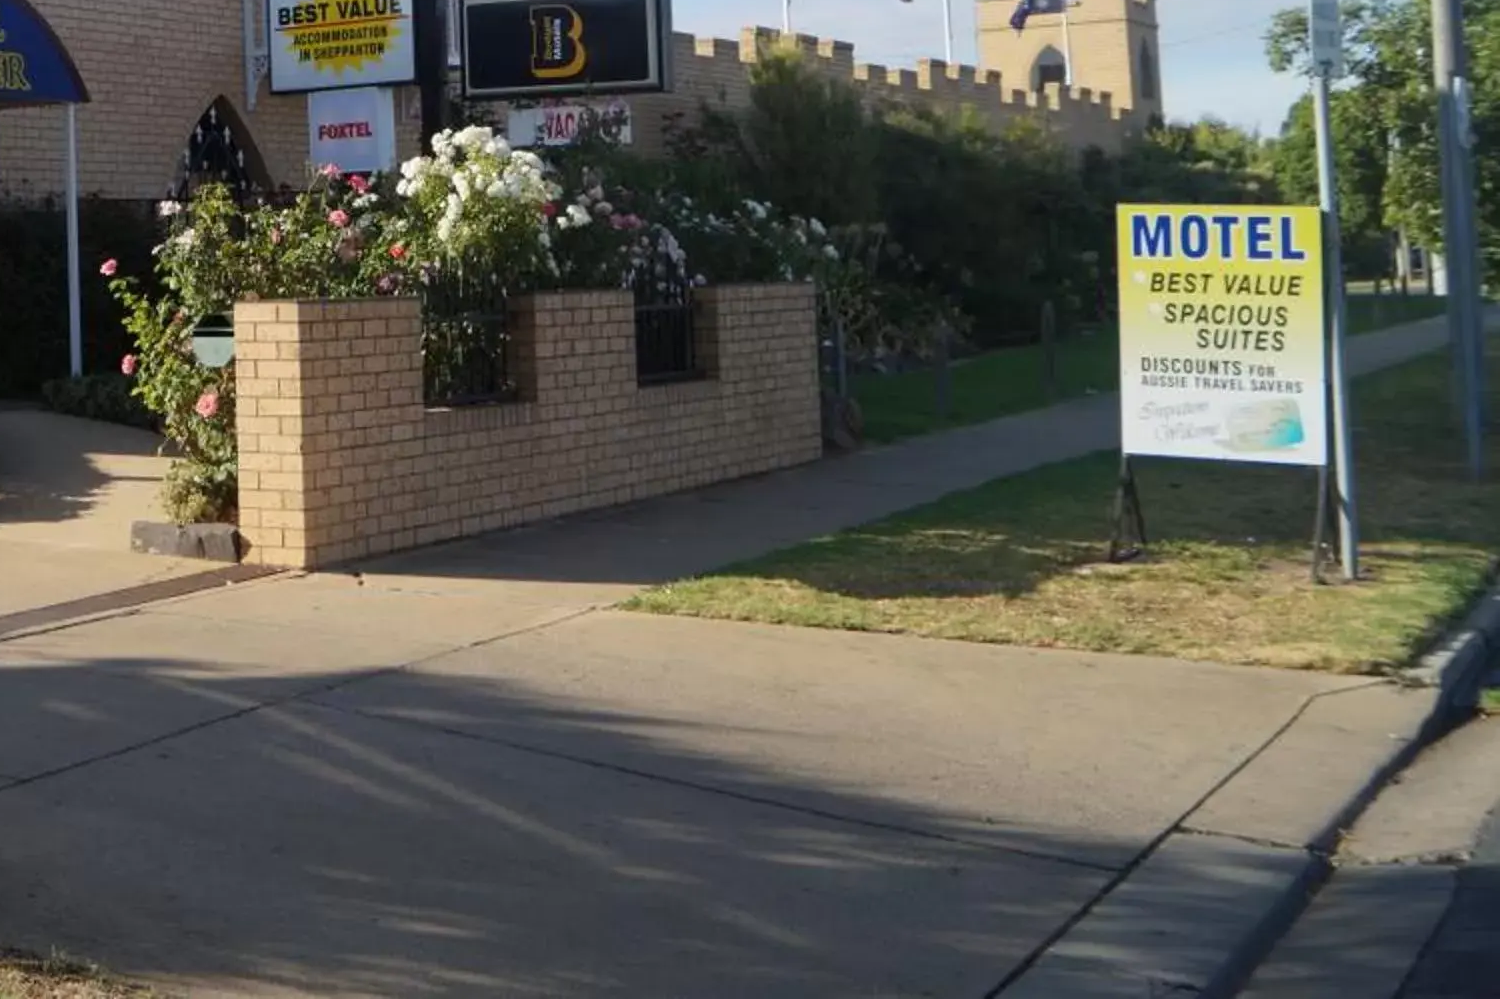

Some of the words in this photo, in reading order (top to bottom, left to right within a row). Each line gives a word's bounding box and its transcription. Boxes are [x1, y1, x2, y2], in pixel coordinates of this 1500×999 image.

[277, 2, 329, 26] BEST
[294, 26, 388, 45] ACCOMMODATION
[299, 49, 311, 62] IN
[314, 41, 386, 60] SHEPPARTON
[318, 122, 373, 141] FOXTEL
[1131, 214, 1306, 261] MOTEL
[1150, 272, 1214, 293] BEST
[1224, 274, 1304, 296] VALUE
[1163, 303, 1289, 326] SPACIOUS
[1196, 328, 1286, 351] SUITES
[1141, 357, 1243, 376] DISCOUNTS
[1249, 364, 1275, 378] FOR
[1140, 376, 1189, 389] AUSSIE
[1194, 378, 1244, 392] TRAVEL
[1250, 379, 1304, 394] SAVERS
